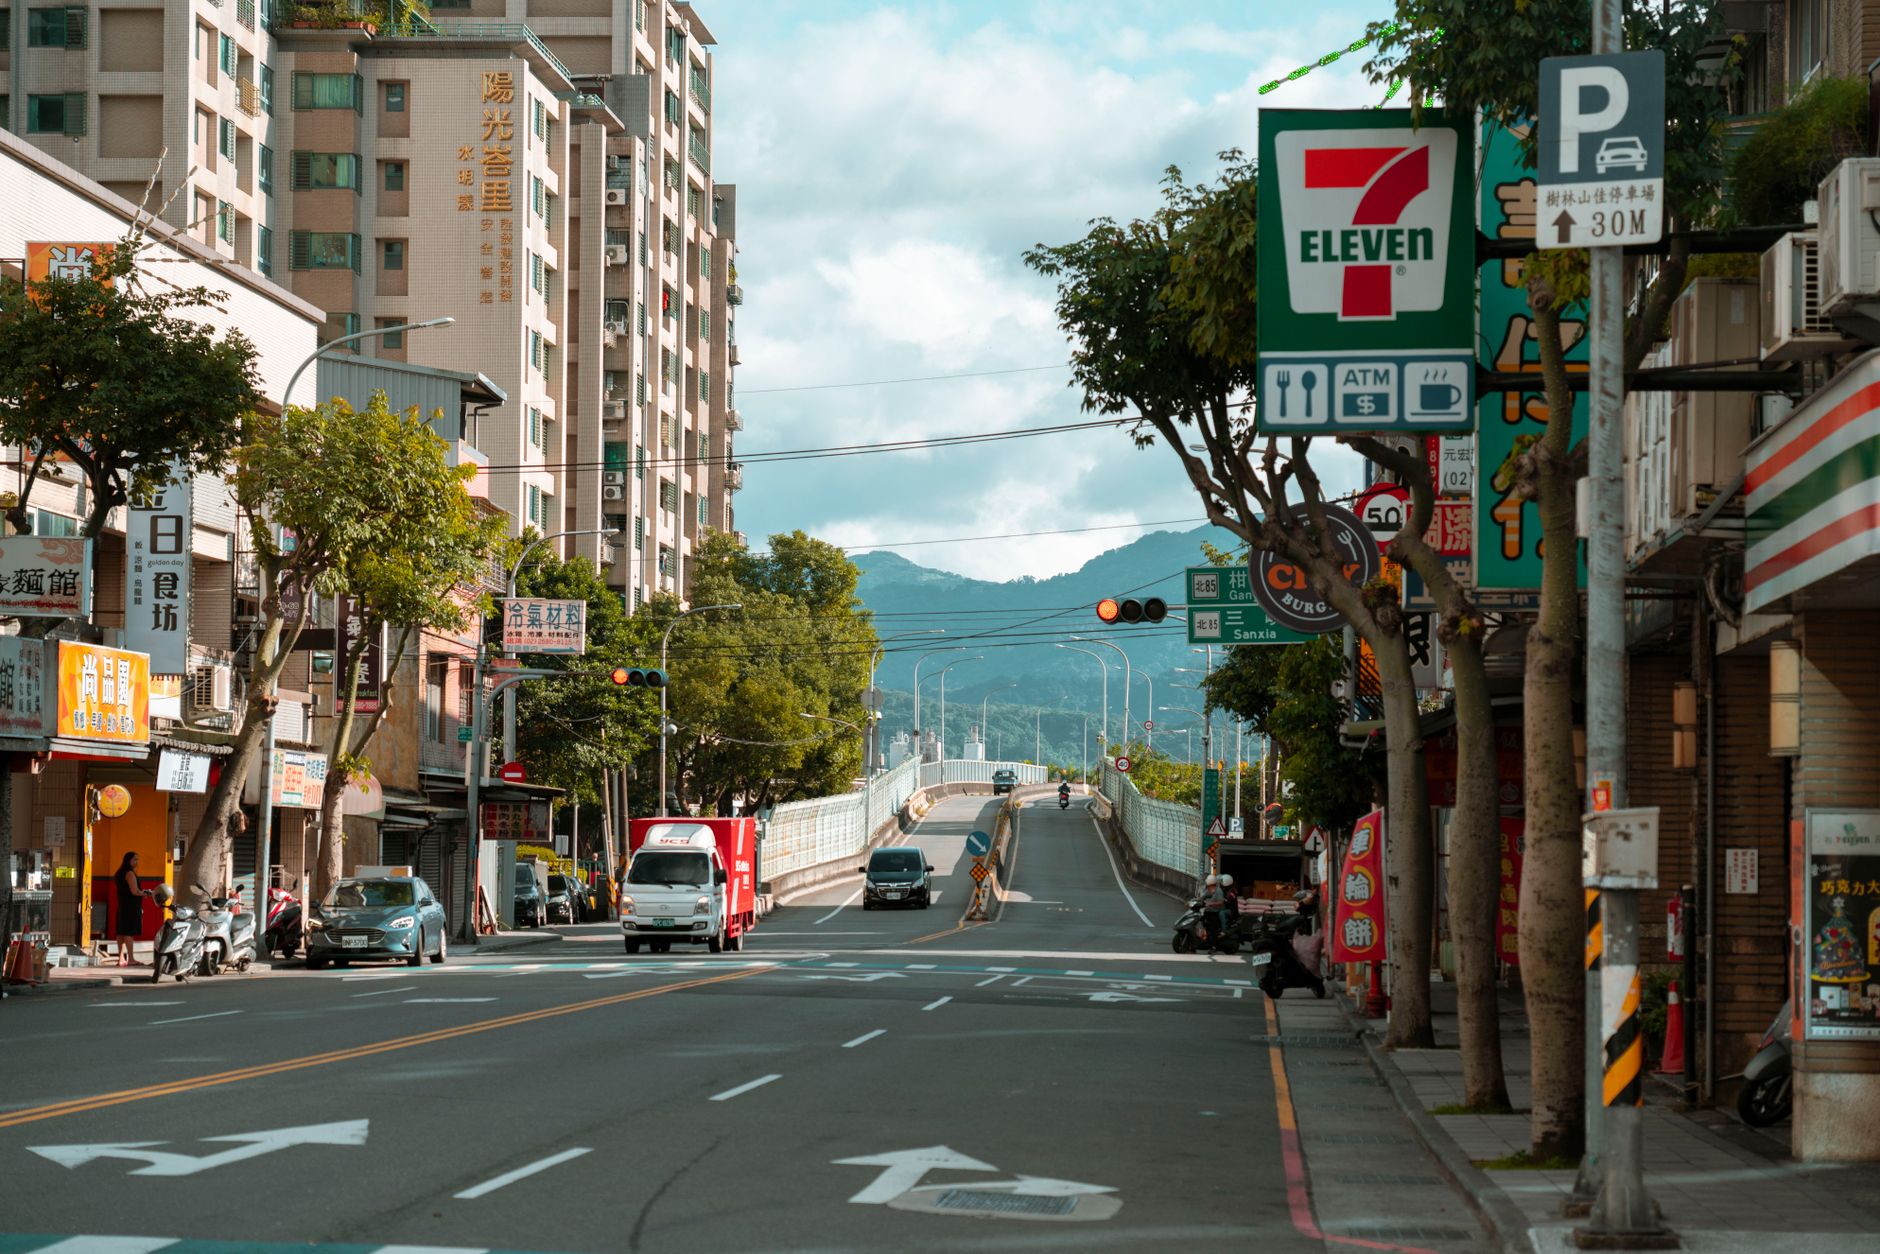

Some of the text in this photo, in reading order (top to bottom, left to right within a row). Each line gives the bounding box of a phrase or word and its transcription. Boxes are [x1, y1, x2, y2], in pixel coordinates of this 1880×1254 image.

[1559, 66, 1629, 174] P
[1545, 184, 1655, 208] 樹林山佳停車場
[1591, 208, 1646, 238] 30M
[1343, 369, 1390, 387] ATM
[1443, 449, 1473, 462] 元宏
[1367, 507, 1400, 524] 50
[171, 559, 185, 567] day
[1267, 563, 1360, 590] CIY
[1229, 590, 1257, 602] Gan
[1282, 592, 1333, 614] BURG
[507, 602, 581, 630] 冷氣材料
[1233, 629, 1277, 640] Sanxia
[1231, 818, 1240, 831] P
[1344, 828, 1372, 947] 車輪餅
